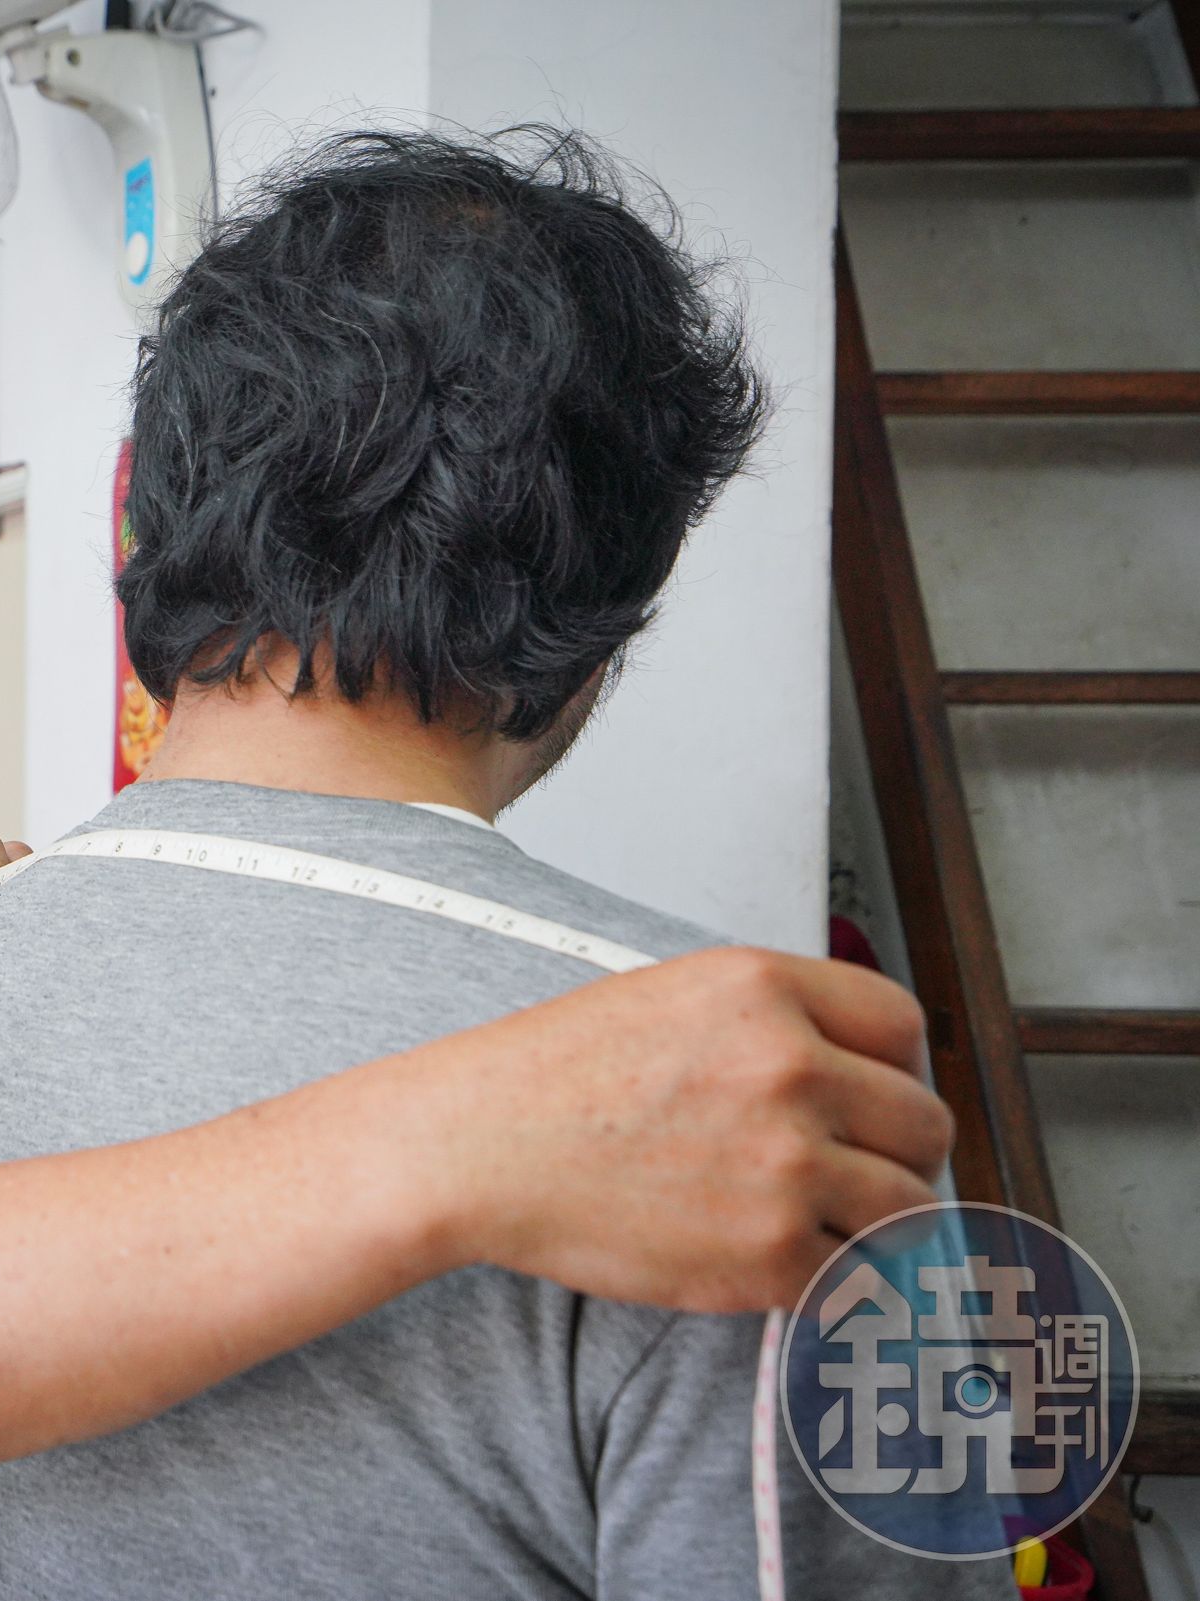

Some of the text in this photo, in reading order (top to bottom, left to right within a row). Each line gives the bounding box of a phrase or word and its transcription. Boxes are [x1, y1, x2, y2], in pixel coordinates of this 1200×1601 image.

[154, 844, 163, 856] 9
[186, 848, 208, 863] 10
[238, 855, 259, 871] 11
[292, 866, 318, 882] 12
[352, 878, 380, 895] 13
[416, 894, 445, 909] 14
[485, 914, 516, 930] 15
